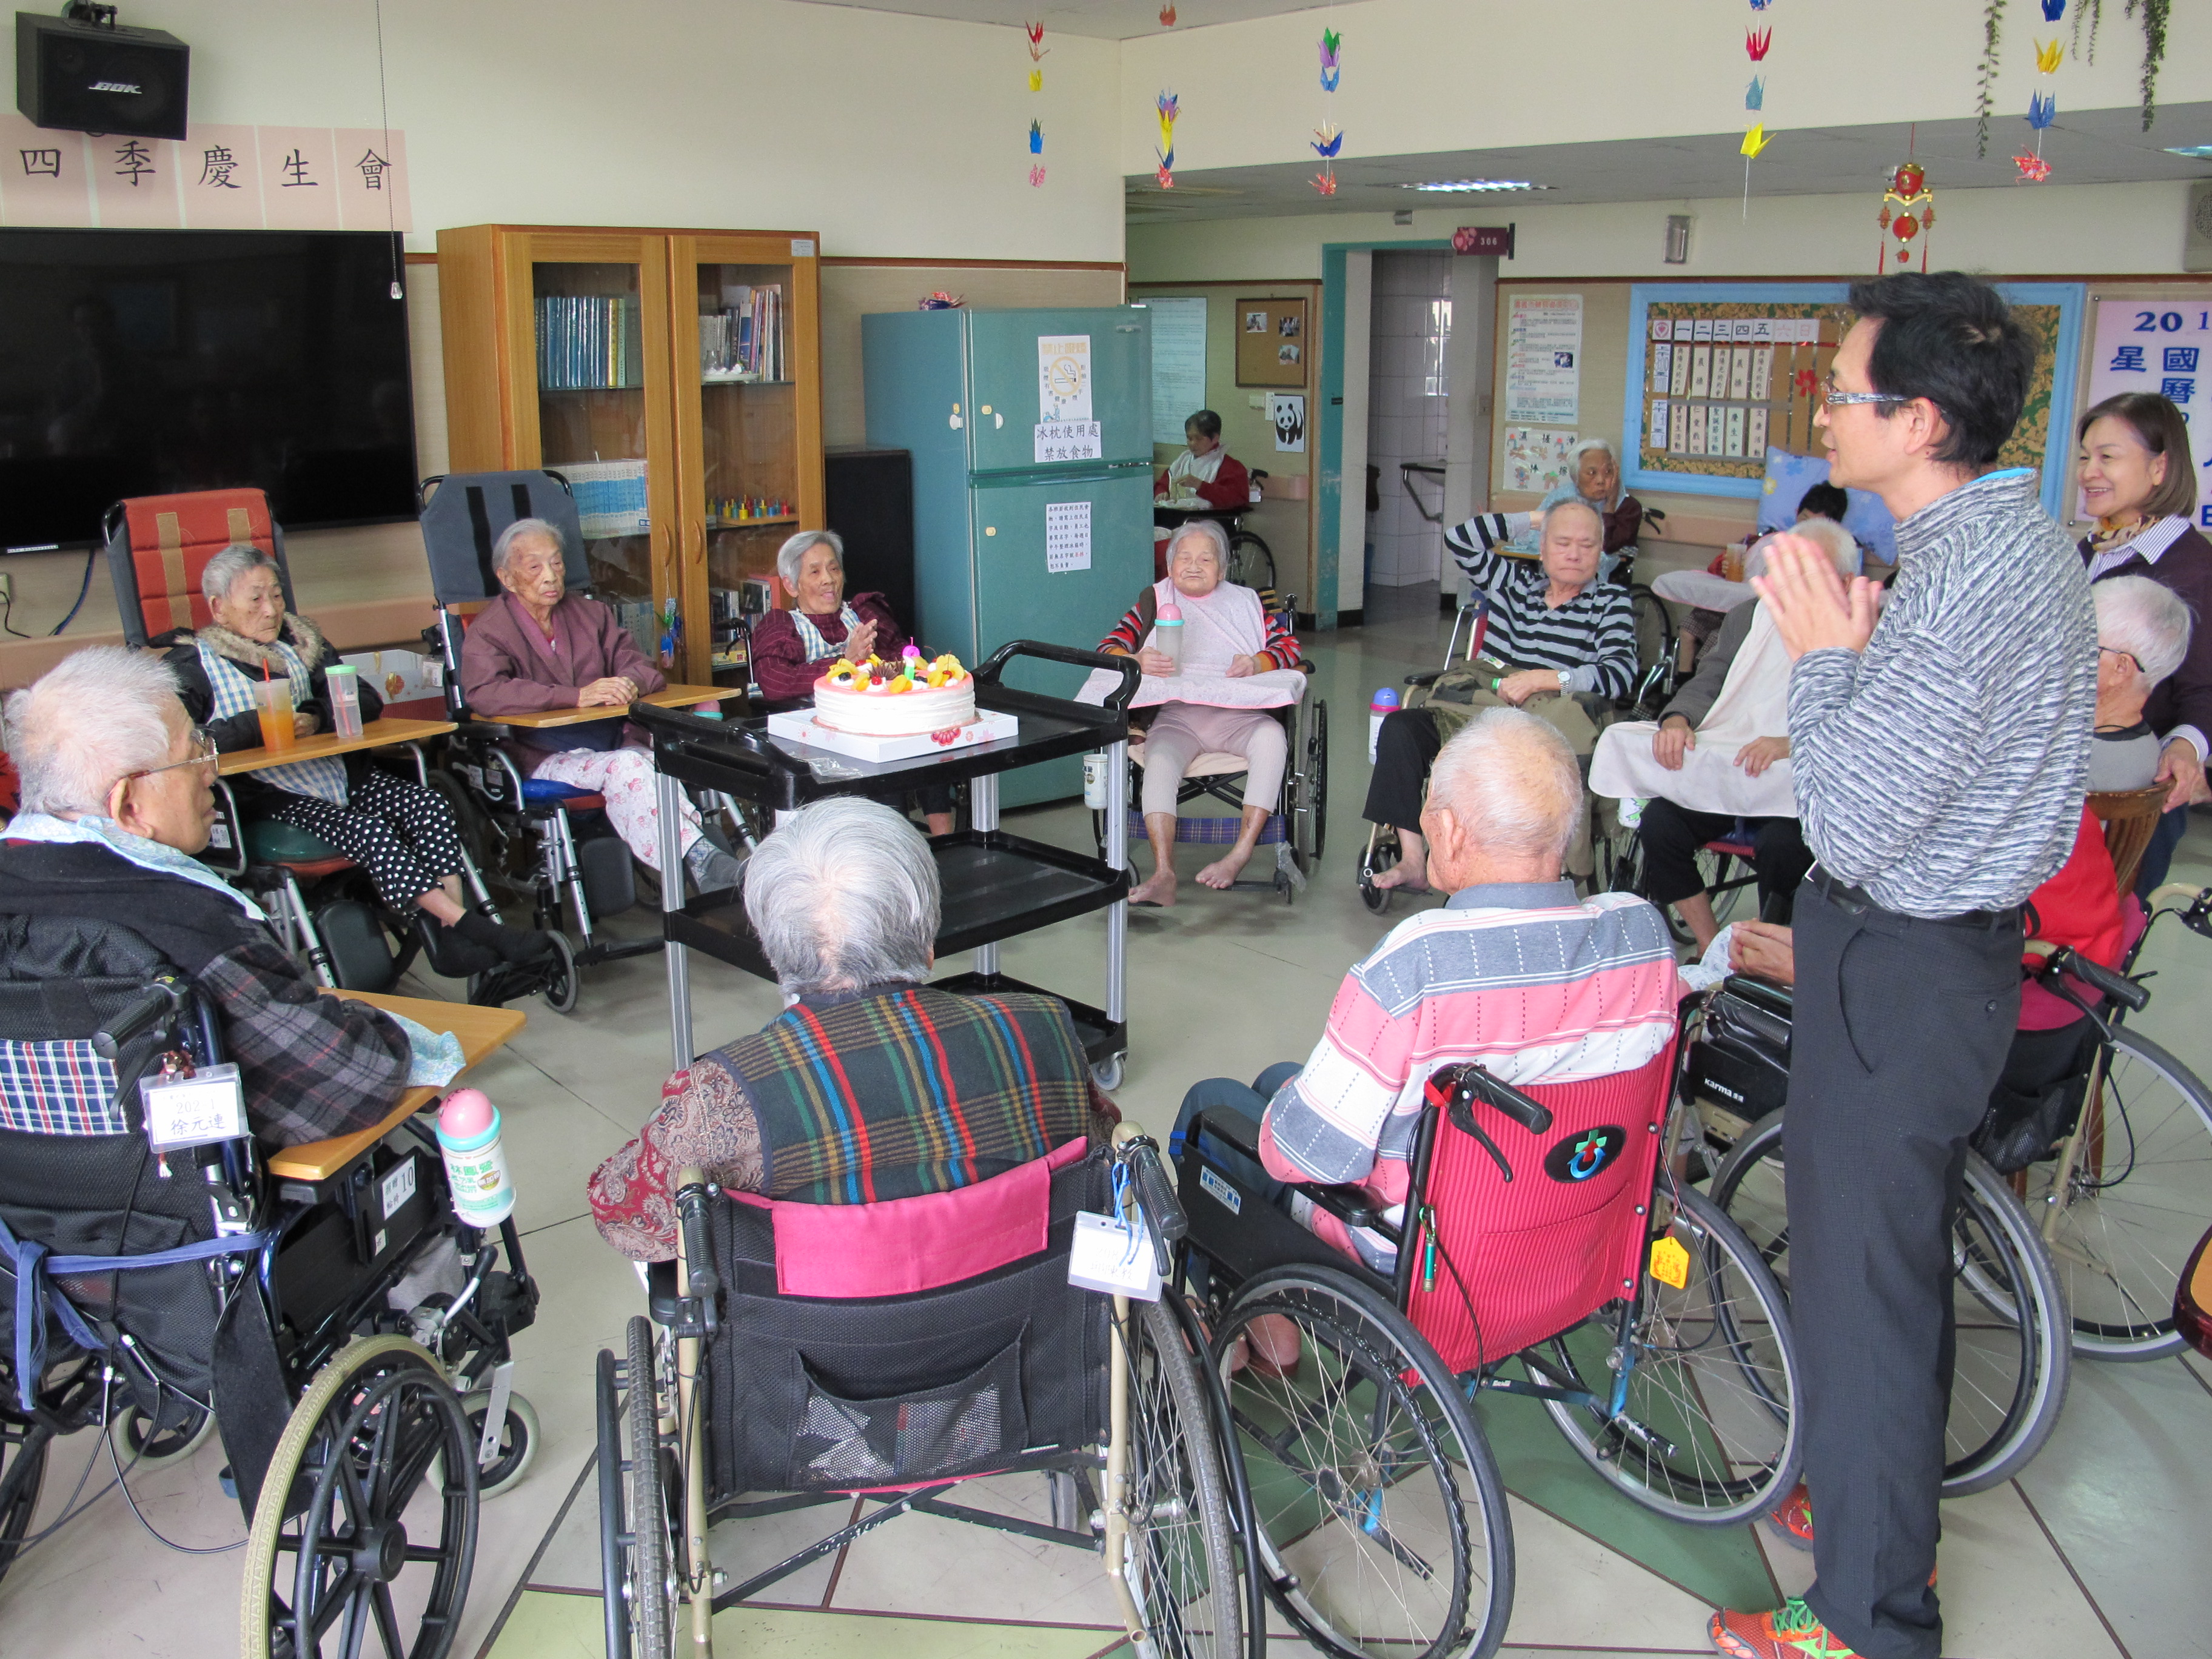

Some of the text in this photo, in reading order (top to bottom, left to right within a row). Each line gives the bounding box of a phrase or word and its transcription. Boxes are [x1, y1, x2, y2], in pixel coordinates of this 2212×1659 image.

[89, 82, 142, 93] BOK
[20, 140, 392, 191] 四季慶生會
[1480, 237, 1498, 246] 306
[1696, 326, 1711, 335] 二
[1715, 324, 1729, 337] 三
[1736, 326, 1749, 335] 四
[1755, 323, 1769, 335] 五
[2110, 346, 2147, 372] 星
[2161, 347, 2199, 404] 國曆
[1037, 423, 1099, 440] 冰枕使用處
[1045, 444, 1093, 461] 禁放食物
[176, 1099, 215, 1114] 202-1
[170, 1113, 227, 1135] 徐元連
[401, 1166, 414, 1193] 10
